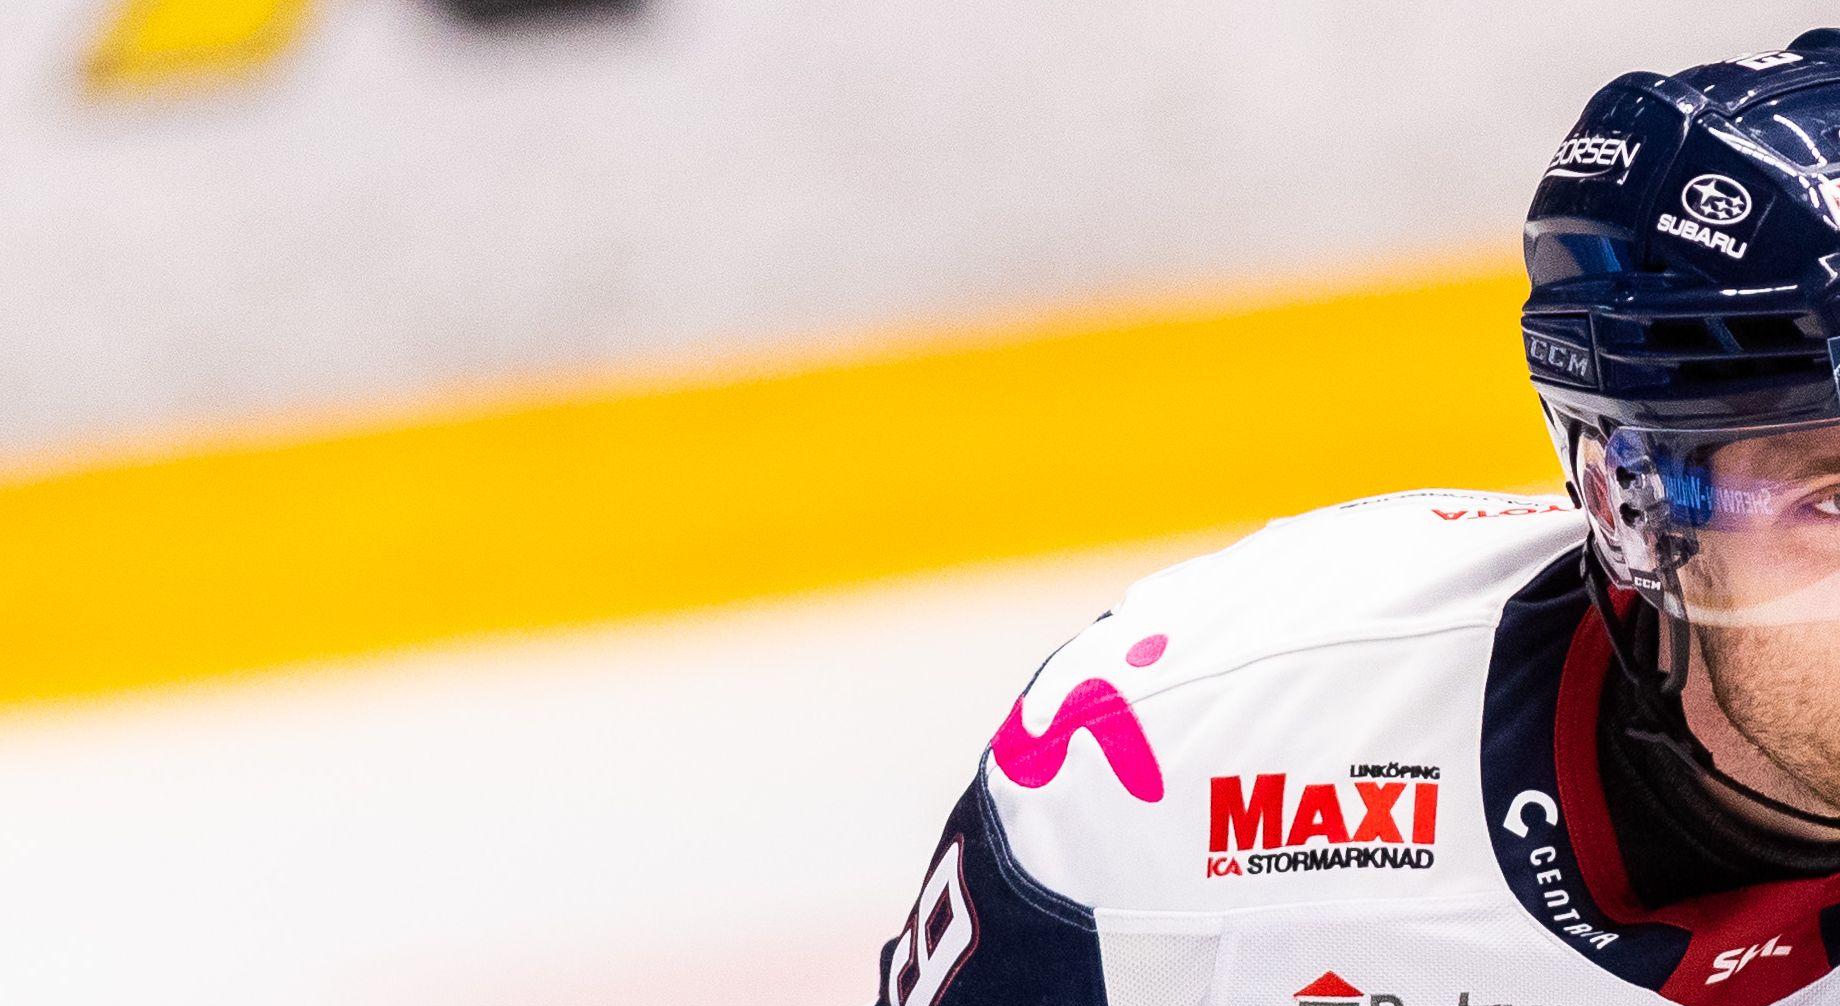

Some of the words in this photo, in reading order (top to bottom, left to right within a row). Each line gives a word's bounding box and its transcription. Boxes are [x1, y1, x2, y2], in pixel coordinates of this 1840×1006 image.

[1656, 213, 1748, 260] SUBARU
[1530, 336, 1589, 377] CCM
[1633, 576, 1662, 592] CCM
[1350, 762, 1441, 780] LINKÖPING
[1208, 772, 1439, 853] MAXI
[1206, 856, 1243, 879] ICA
[1246, 847, 1435, 875] STORMARKNAD
[1529, 845, 1623, 951] CENTRIA
